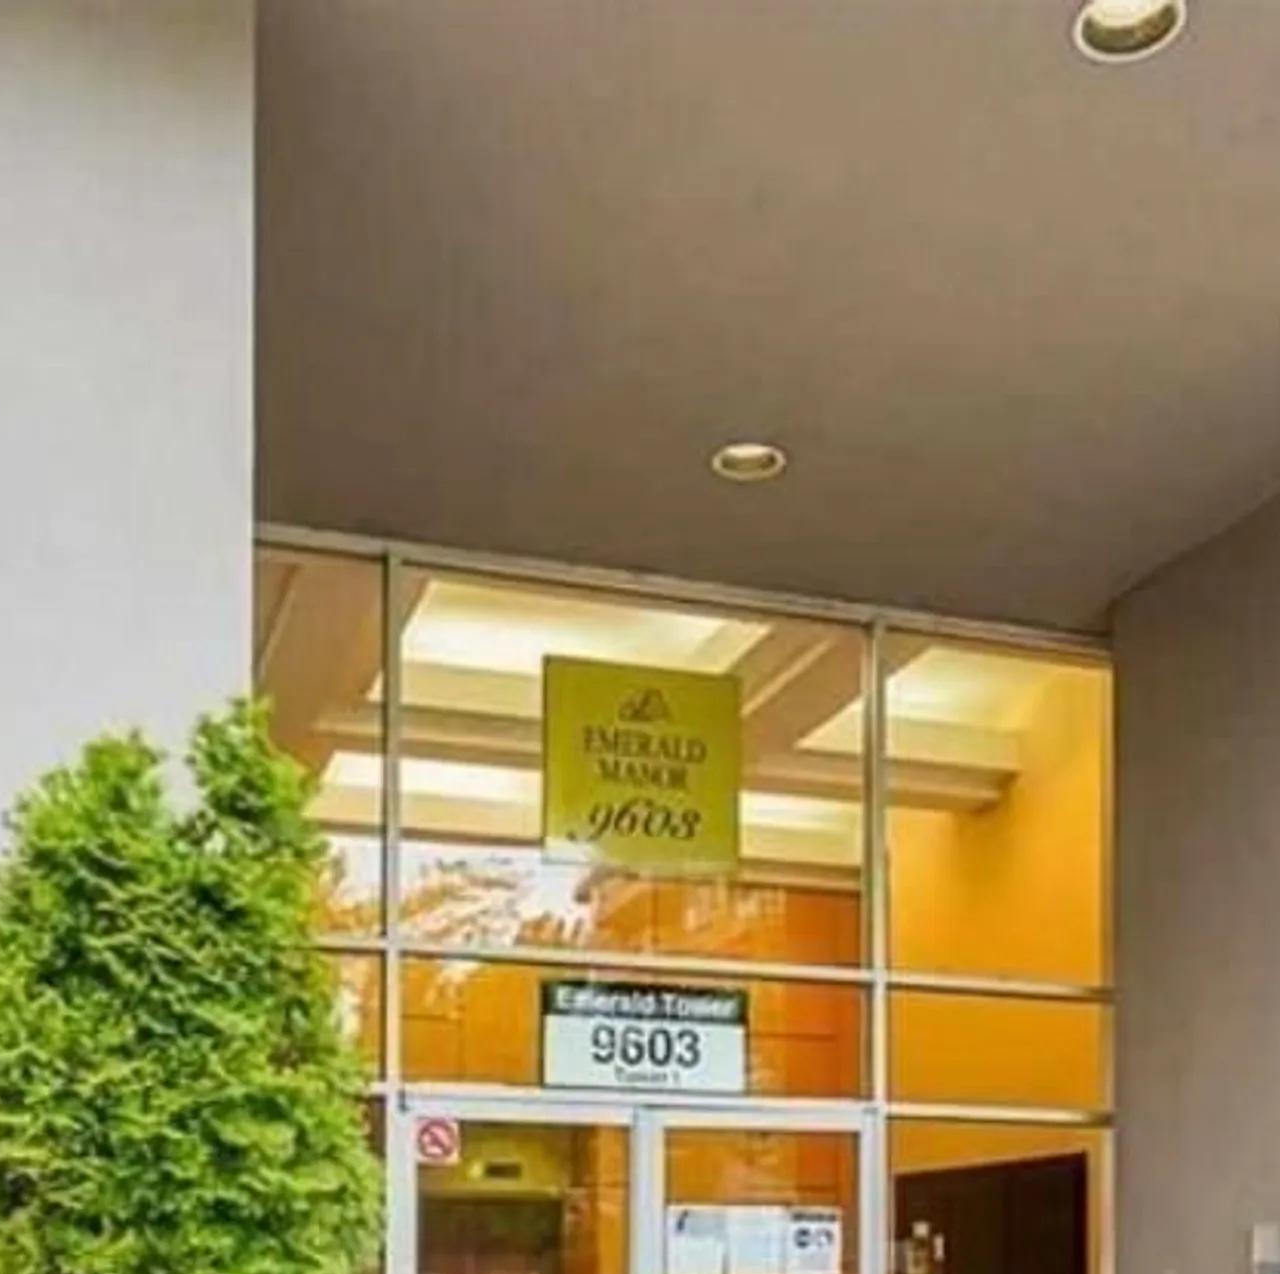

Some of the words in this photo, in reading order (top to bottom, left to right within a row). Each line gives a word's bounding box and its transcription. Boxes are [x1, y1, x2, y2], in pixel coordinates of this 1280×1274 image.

[582, 724, 709, 764] EMERALD
[597, 757, 690, 791] MANOR
[591, 1024, 702, 1068] 9603
